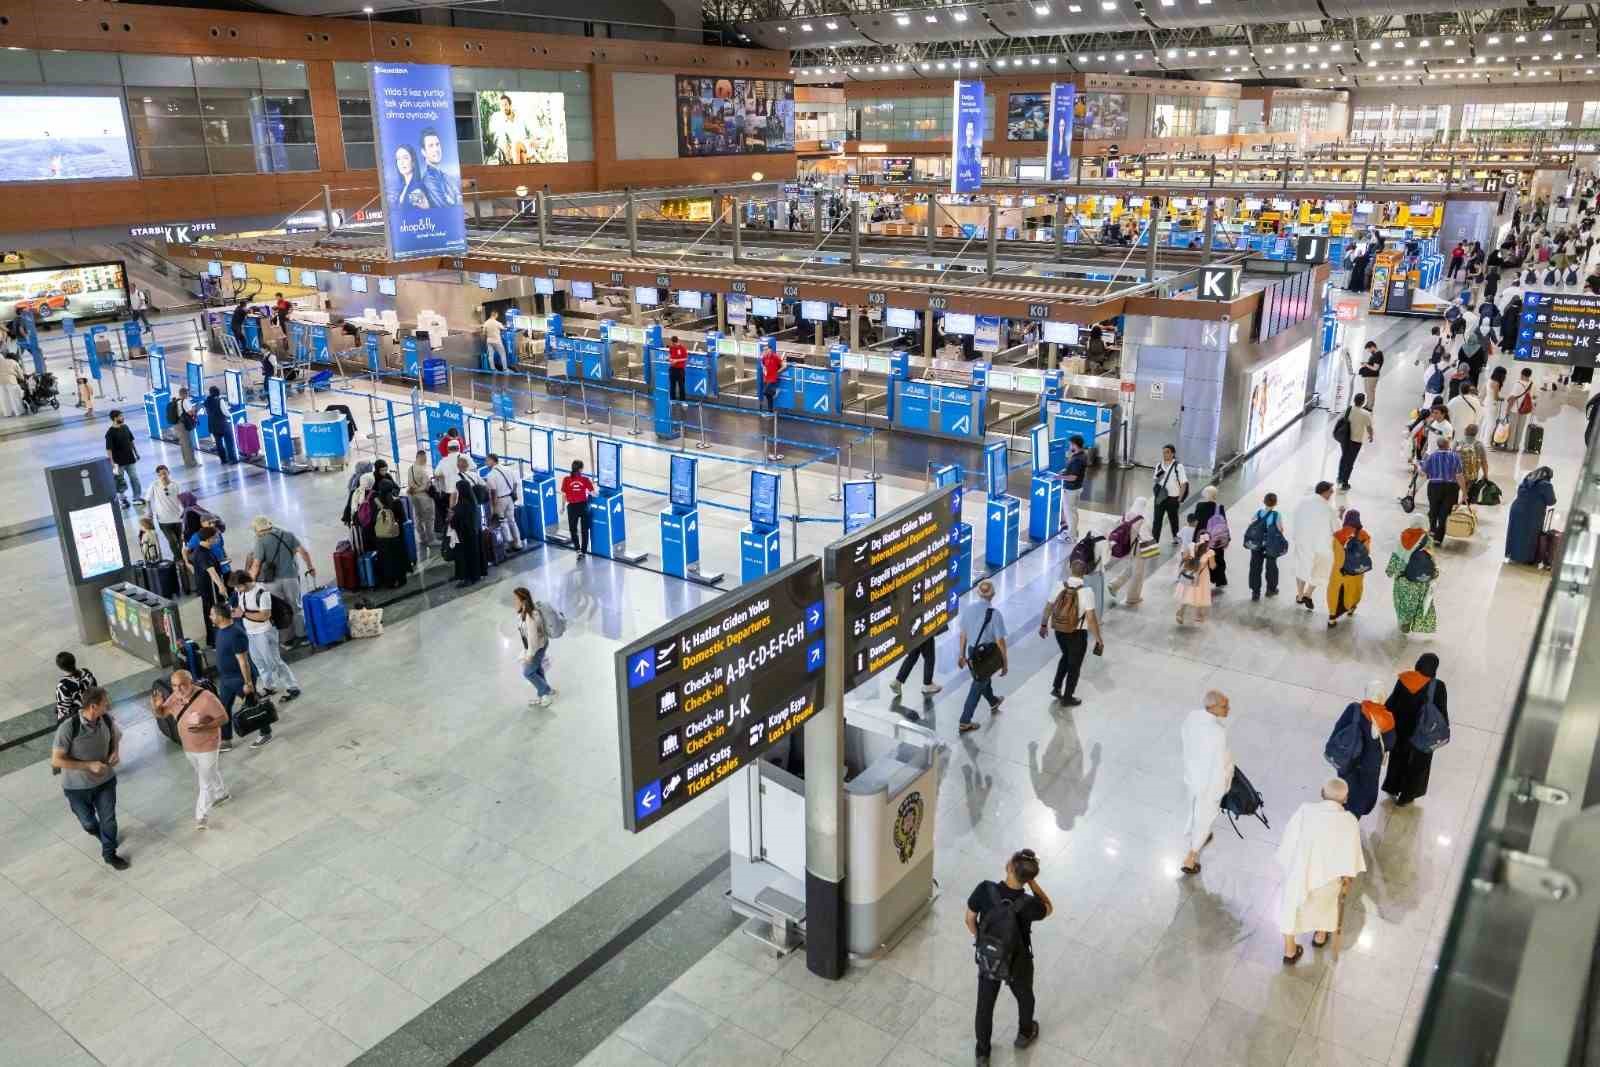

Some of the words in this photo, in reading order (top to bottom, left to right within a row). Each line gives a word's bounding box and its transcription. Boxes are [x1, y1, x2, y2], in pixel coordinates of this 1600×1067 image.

[1486, 180, 1497, 191] H
[1506, 173, 1516, 185] G
[177, 227, 191, 243] K
[1305, 239, 1317, 260] J
[732, 281, 746, 292] K05
[783, 286, 798, 297] K04
[1203, 271, 1225, 297] K
[869, 293, 885, 304] K03
[929, 297, 946, 309] K02
[1030, 304, 1048, 318] K01
[1551, 315, 1577, 323] Check-in
[1547, 332, 1574, 340] Check-in
[1574, 335, 1590, 347] J-K
[871, 538, 881, 551] Dış
[882, 529, 901, 545] Hatlar
[901, 519, 918, 535] Giden
[918, 511, 933, 525] Yolcu
[871, 535, 909, 566] International
[909, 522, 939, 545] Departures
[870, 568, 891, 587] Engelli
[891, 562, 905, 576] Yolcu
[906, 550, 927, 568] Danışma
[870, 577, 896, 603] Disabled
[924, 590, 935, 604] First
[935, 581, 945, 594] Aid
[682, 636, 691, 653] İç
[693, 625, 720, 648] Hatlar
[722, 611, 747, 631] Giden
[748, 599, 770, 618] Yolcu
[870, 605, 892, 623] Eczane
[870, 614, 900, 638] Pharmacy
[682, 641, 725, 670] Domestic
[726, 615, 771, 648] Departures
[870, 636, 896, 659] Danışma
[684, 666, 723, 695] Check-in
[726, 621, 804, 685] A-B-C-D-E-F-G-H
[869, 644, 905, 673] Information
[685, 684, 724, 712] Check-in
[686, 708, 725, 738] Check-in
[727, 694, 751, 727] J-K
[768, 708, 789, 728] Kayıp
[790, 696, 806, 714] Eşya
[768, 724, 785, 743] Lost
[785, 720, 792, 731] &
[792, 702, 816, 727] Found
[687, 724, 726, 754] Check-in
[687, 758, 709, 780] Bilet
[710, 745, 732, 767] Satış
[687, 772, 715, 795] Ticket
[716, 757, 739, 778] Sales
